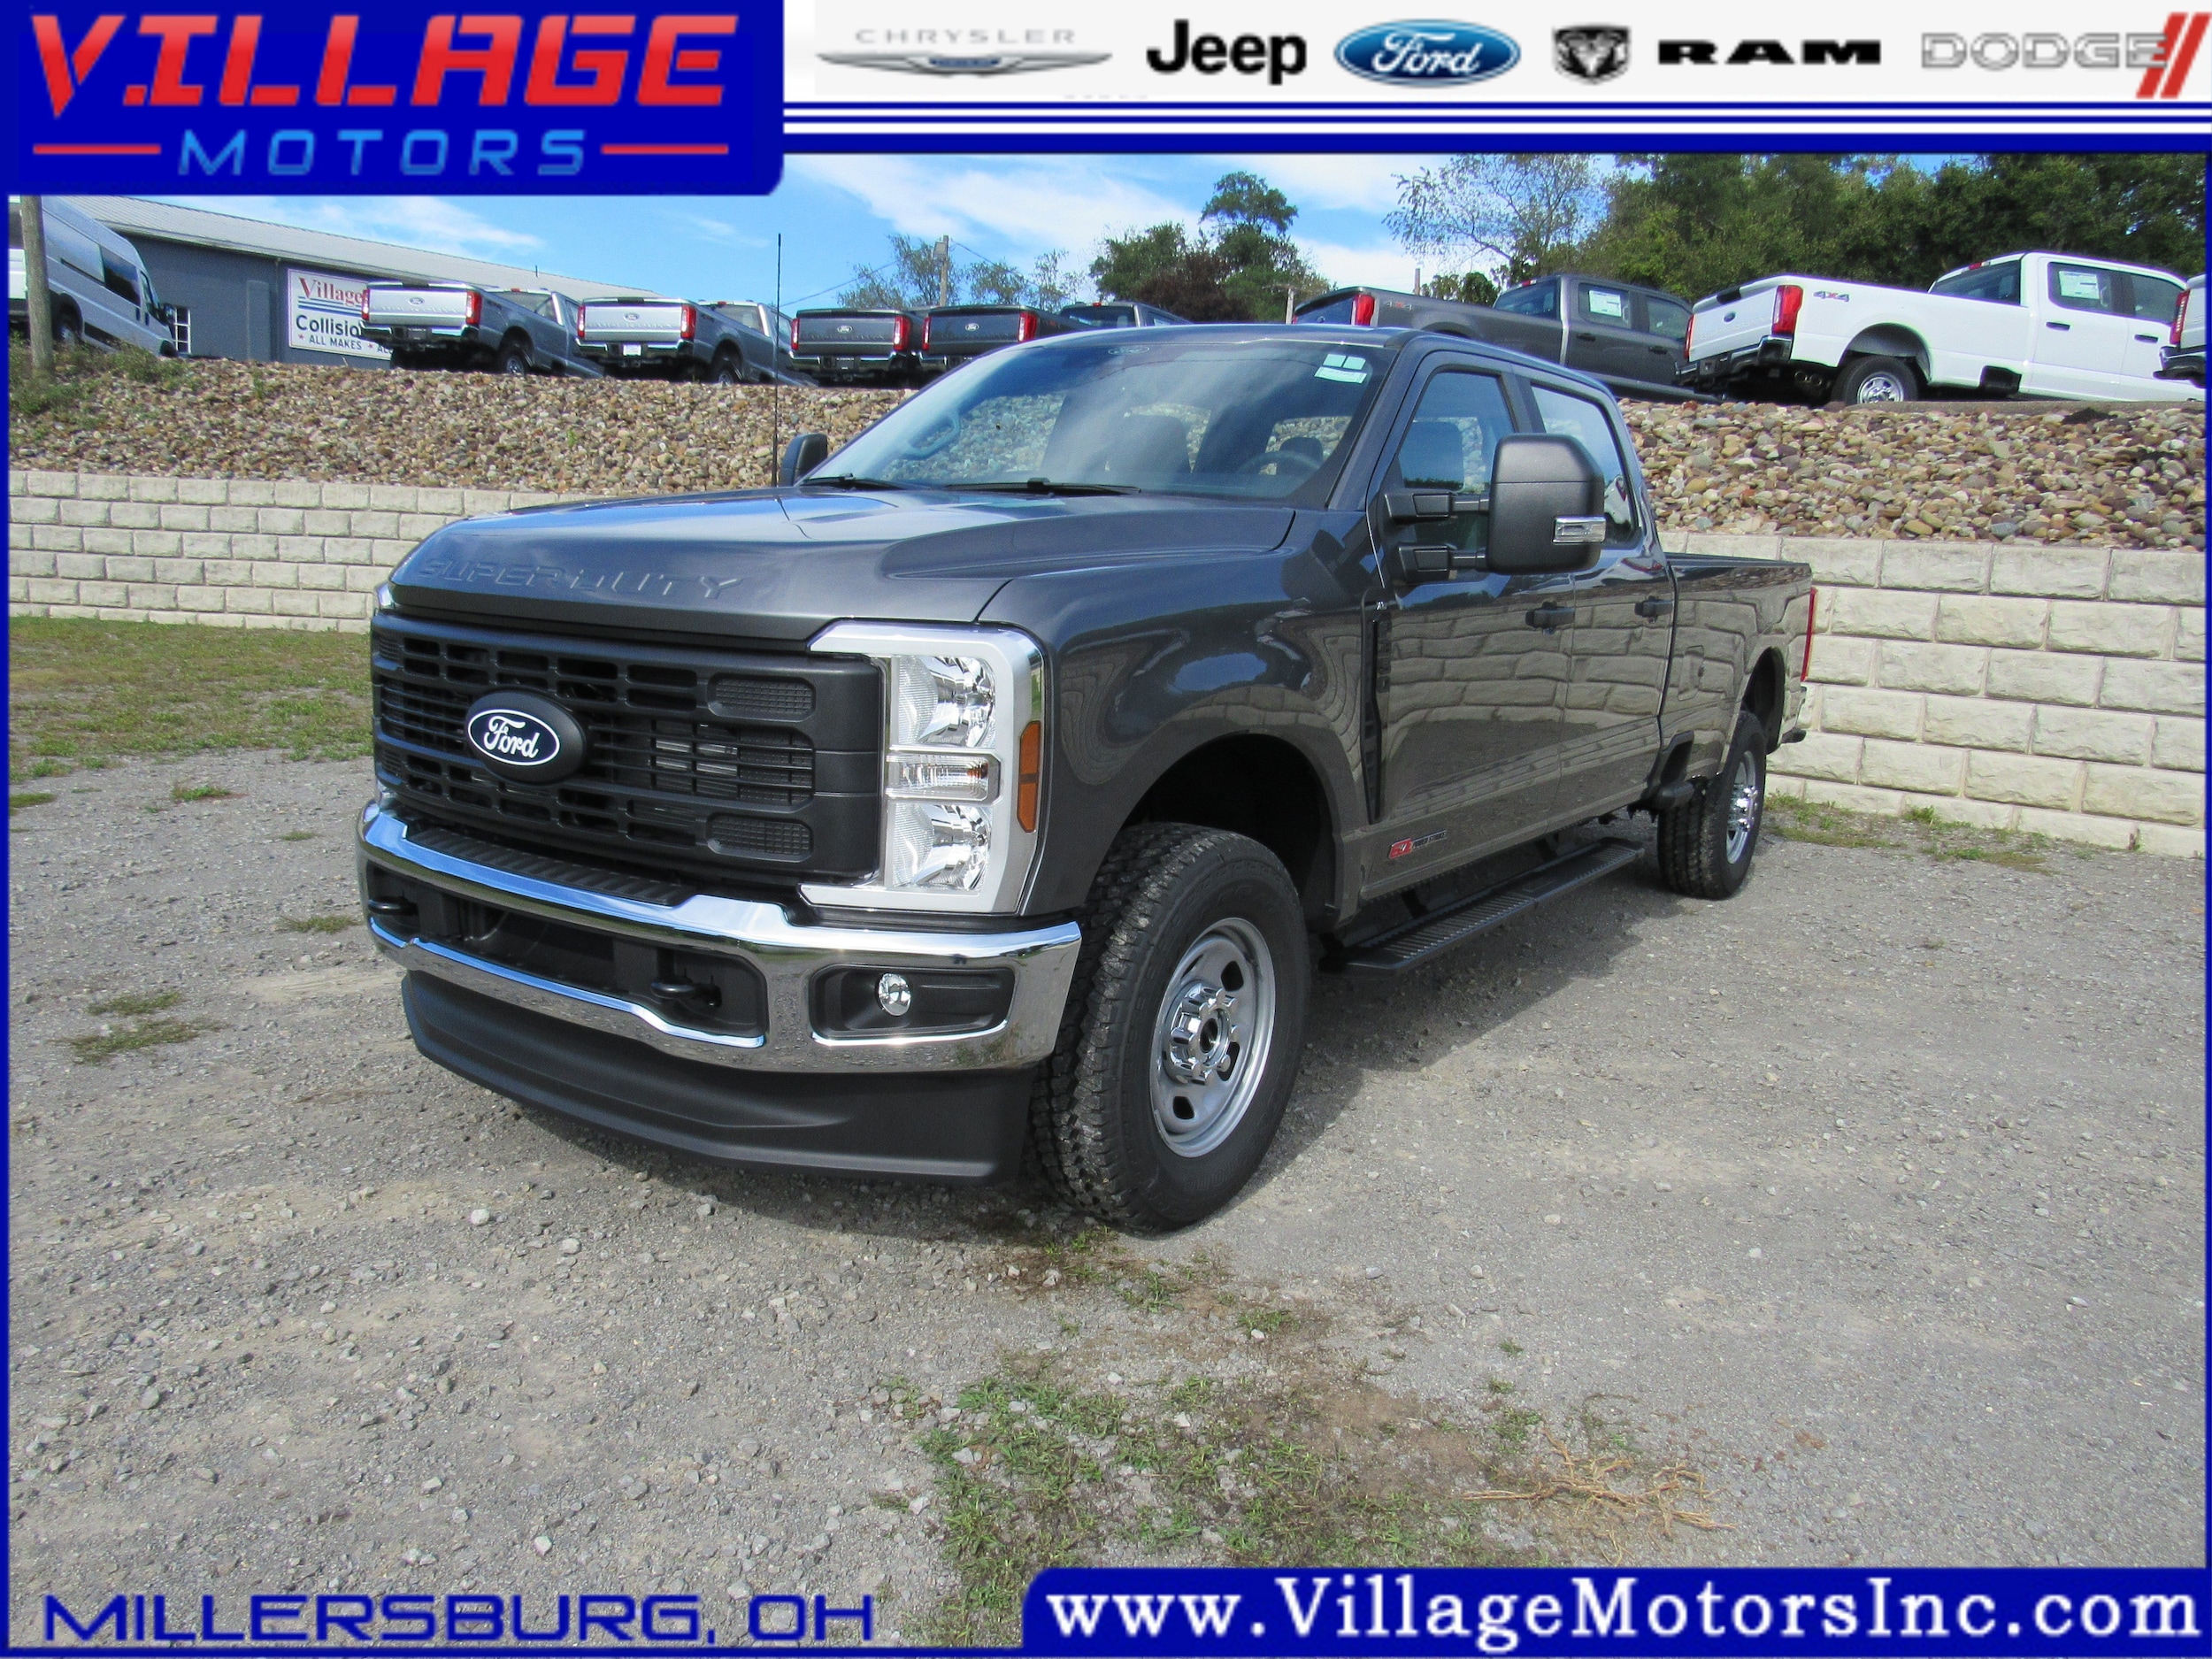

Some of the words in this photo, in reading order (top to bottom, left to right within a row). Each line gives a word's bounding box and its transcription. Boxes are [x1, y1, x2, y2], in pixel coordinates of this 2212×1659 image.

[298, 277, 364, 306] Village
[296, 315, 361, 337] Collisio
[309, 334, 326, 346] ALL
[329, 337, 363, 350] MAKES
[418, 557, 567, 587] SUPER
[570, 568, 743, 600] DUTY
[483, 715, 541, 759] Ford
